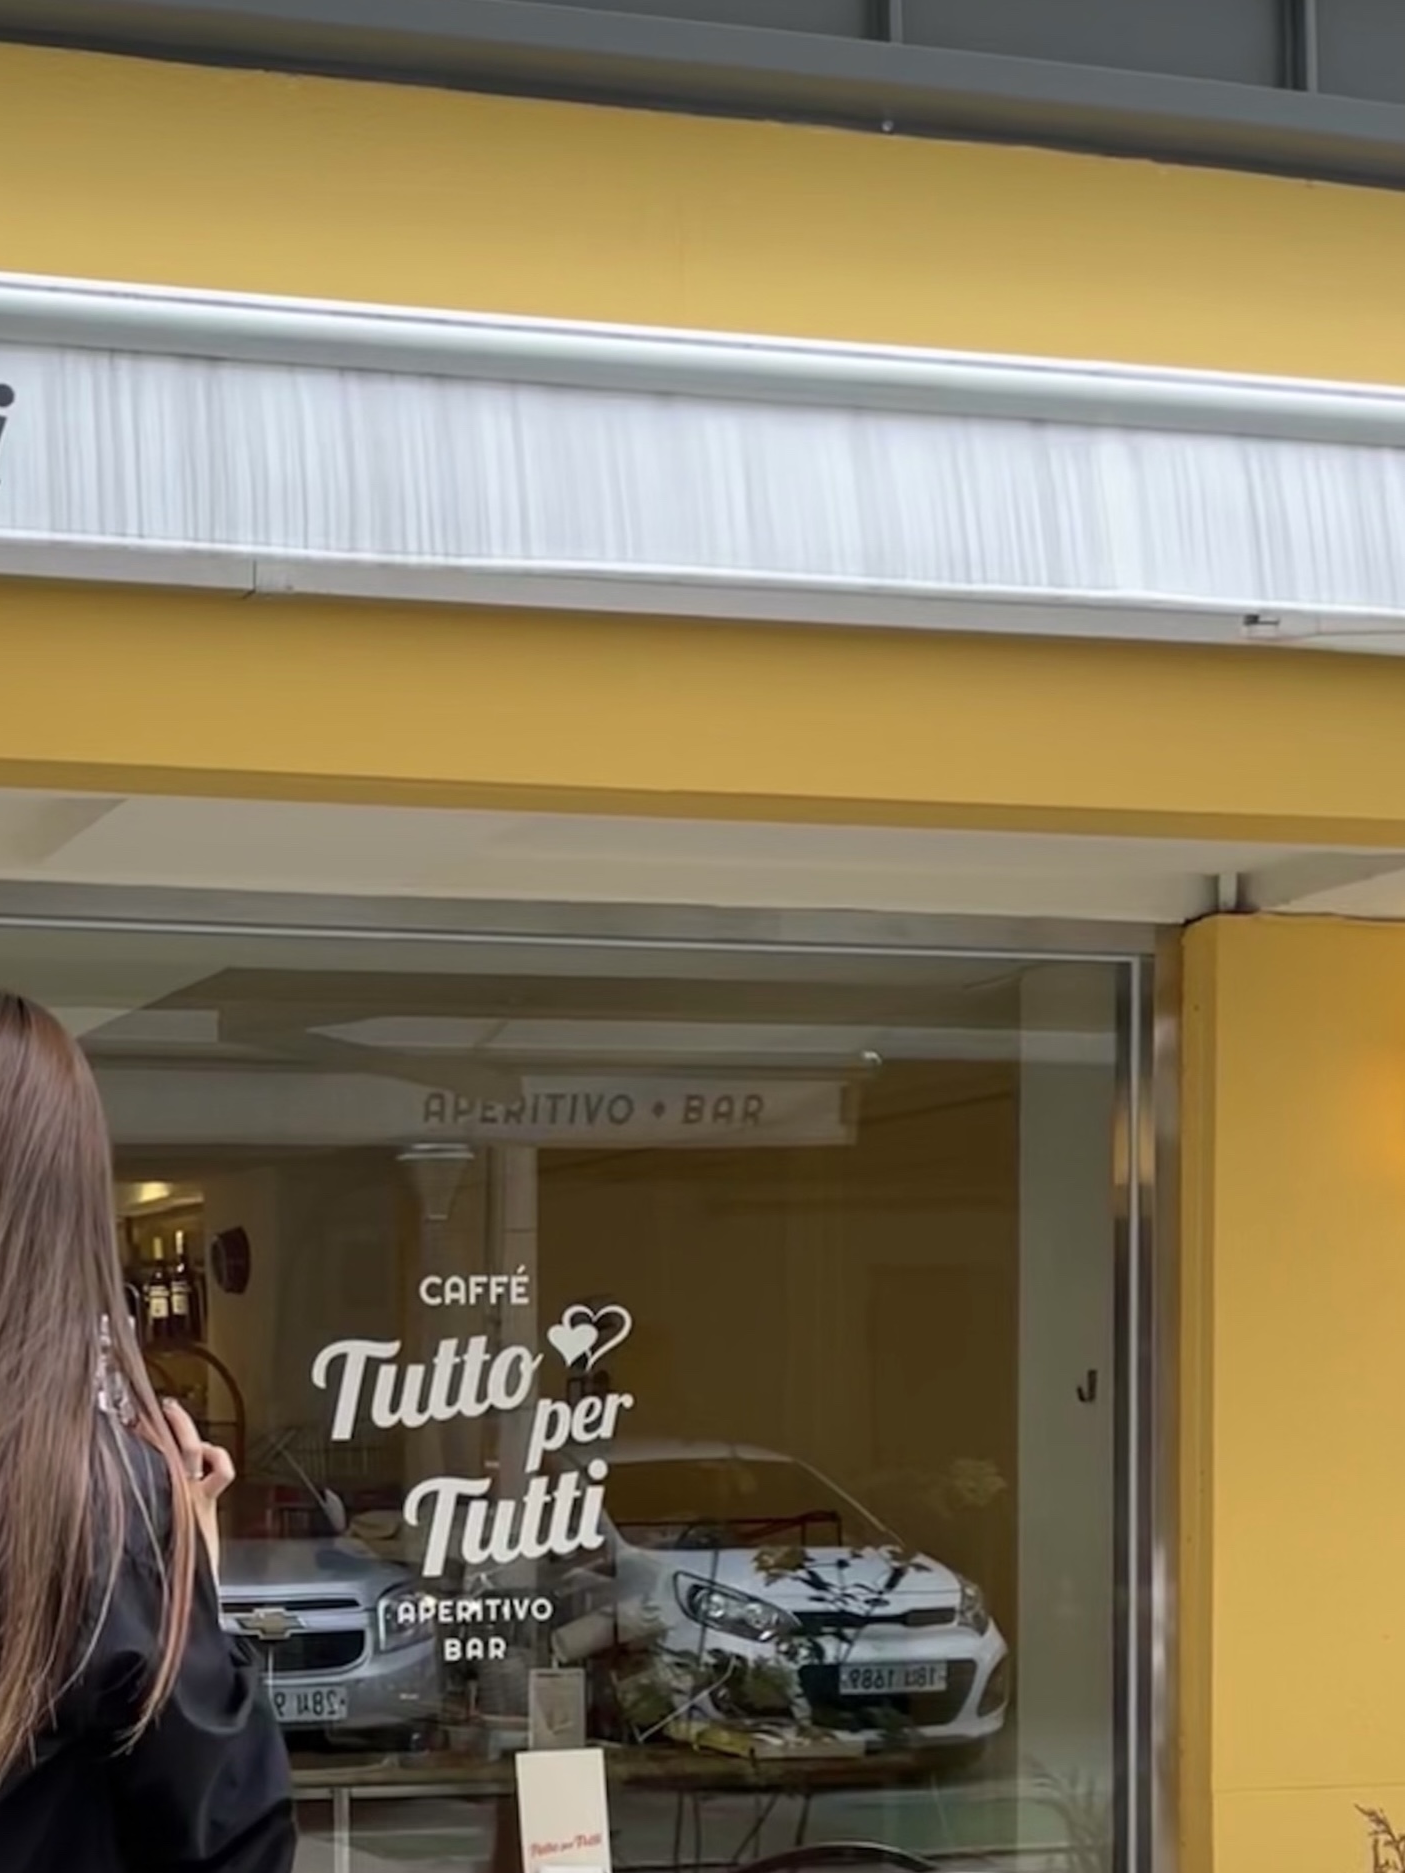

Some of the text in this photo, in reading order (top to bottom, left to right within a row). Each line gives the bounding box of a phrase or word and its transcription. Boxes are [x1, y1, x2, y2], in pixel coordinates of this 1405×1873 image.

[423, 1091, 765, 1127] APERITIVO BAR
[419, 1265, 530, 1305] CAFFÉ
[311, 1335, 543, 1441] Tutto
[525, 1391, 634, 1473] per
[402, 1458, 608, 1578] Tutti
[397, 1597, 553, 1624] APERITIVO
[444, 1636, 507, 1662] BAR
